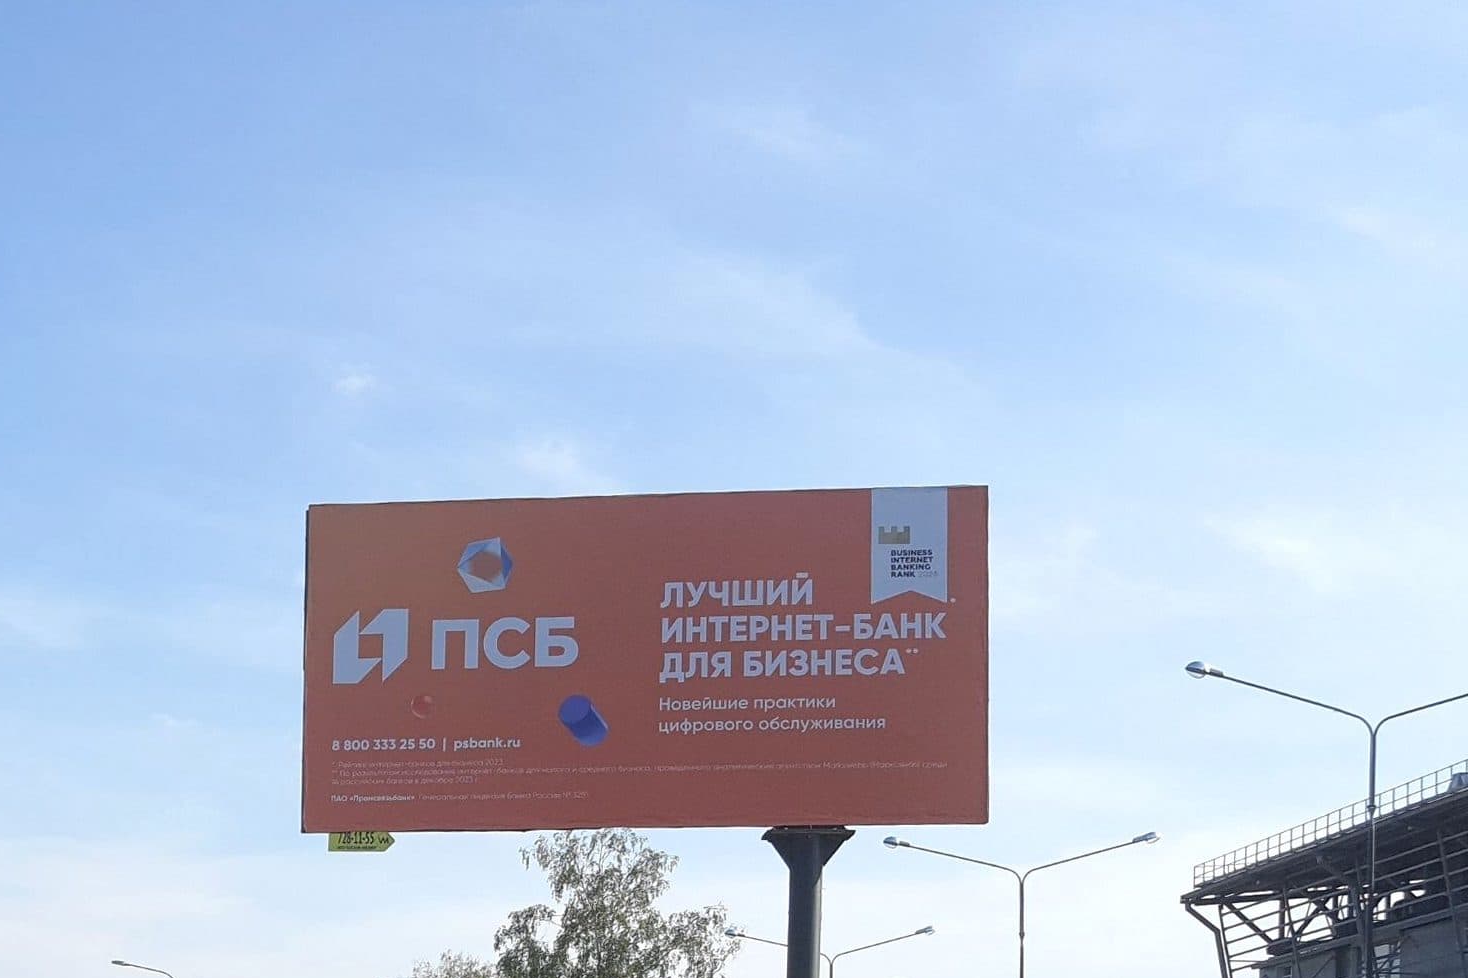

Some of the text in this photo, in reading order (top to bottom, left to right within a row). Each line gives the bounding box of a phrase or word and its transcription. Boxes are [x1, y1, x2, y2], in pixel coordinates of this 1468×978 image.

[660, 572, 813, 608] ЛУЧШИЙ
[431, 616, 579, 670] ПСБ
[661, 612, 947, 644] ИНТЕРНЕТ-БАНК
[659, 651, 732, 683] ДЛЯ
[659, 695, 836, 713] Новейшие практики
[658, 715, 886, 735] цифрового обслуживания
[331, 737, 521, 751] 8 800 333 25 50 psbank.ru
